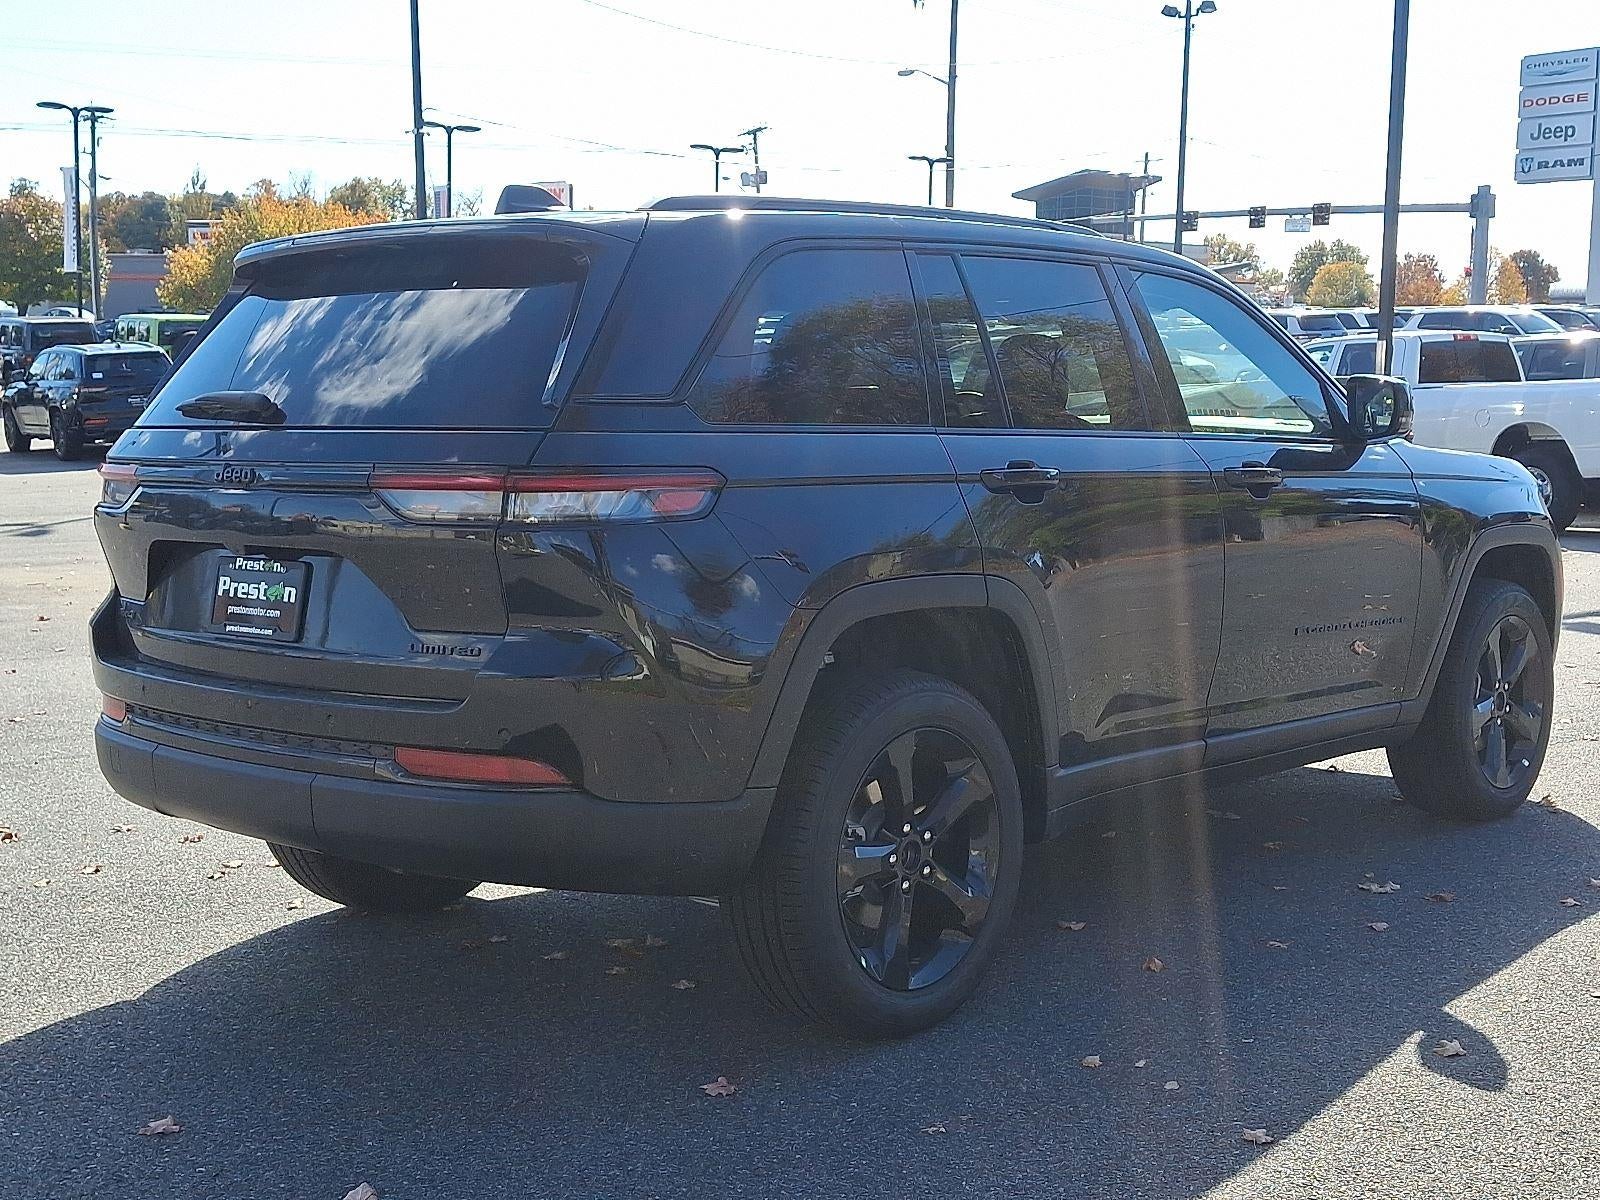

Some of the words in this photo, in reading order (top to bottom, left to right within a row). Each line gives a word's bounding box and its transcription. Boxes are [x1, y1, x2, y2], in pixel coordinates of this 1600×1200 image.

[1526, 57, 1589, 70] CHRYSLER
[1522, 92, 1590, 108] DODGE
[1529, 122, 1576, 142] Jeep
[1537, 157, 1585, 170] RAM
[214, 462, 257, 487] Jeep
[217, 576, 297, 604] Preston
[227, 604, 281, 618] prestonmotor.com
